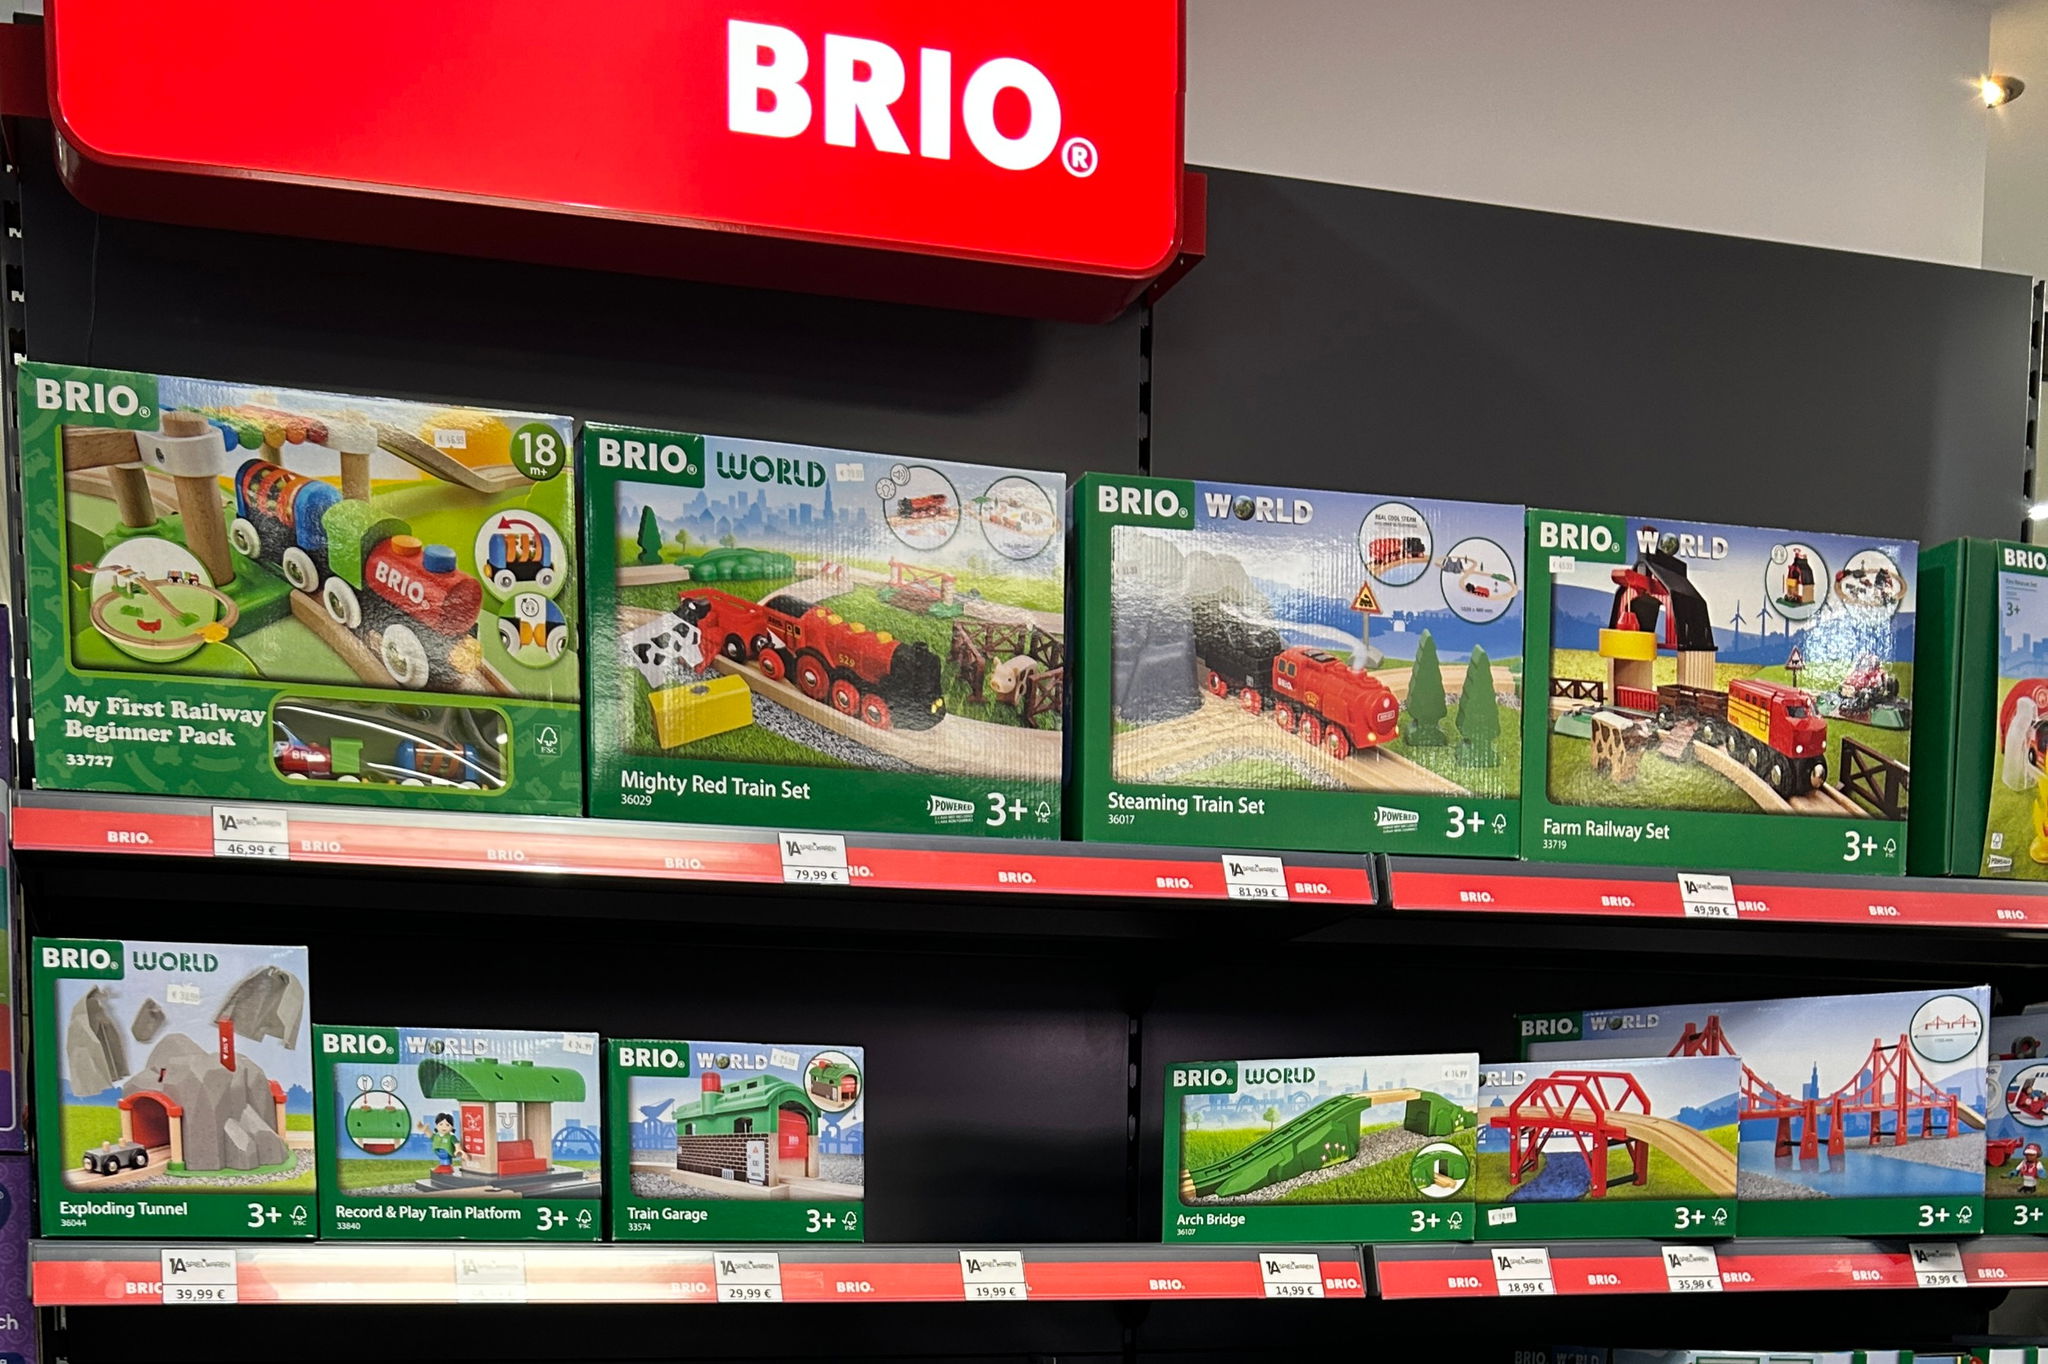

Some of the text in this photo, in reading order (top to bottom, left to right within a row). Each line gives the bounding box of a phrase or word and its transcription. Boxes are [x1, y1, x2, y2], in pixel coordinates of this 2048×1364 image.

[518, 432, 557, 466] 18
[716, 451, 826, 487] WORLD
[1204, 492, 1314, 524] WORLD
[1636, 530, 1729, 559] WORLD
[2006, 601, 2021, 617] 3+
[64, 695, 266, 727] My First Railway
[65, 719, 236, 746] Beginner Pack
[66, 754, 113, 768] 33727
[621, 770, 810, 800] Mighty Red Train Set
[621, 794, 652, 806] 36029
[935, 800, 972, 811] POWERED
[1108, 791, 1265, 815] Steaming Train Set
[986, 792, 1028, 826] 3+
[1382, 810, 1417, 821] POWERED
[1108, 814, 1134, 824] 36017
[1446, 805, 1485, 838] 3+
[1543, 818, 1670, 842] Farm Railway Set
[228, 843, 277, 856] 46,99 €
[1543, 840, 1567, 850] 33719
[1843, 830, 1877, 861] 3+
[795, 869, 838, 881] 79,99 €
[1239, 887, 1278, 899] 81,99 €
[1694, 905, 1729, 916] 49,99 €
[133, 951, 218, 972] WORLD
[1590, 1014, 1659, 1031] WORLD
[407, 1036, 488, 1056] WORLD
[696, 1052, 768, 1070] WORLD
[1245, 1066, 1315, 1084] WORLD
[60, 1202, 188, 1218] Exploding Tunnel
[248, 1203, 282, 1228] 3+
[336, 1205, 521, 1221] Record & Play Train Platform
[627, 1207, 708, 1223] Train Garage
[1675, 1207, 1705, 1228] 3+
[1918, 1205, 1950, 1227] 3+
[2013, 1205, 2043, 1225] 3+
[60, 1219, 87, 1227] 36044
[337, 1222, 360, 1230] 33840
[537, 1207, 568, 1231] 3+
[628, 1223, 651, 1231] 33574
[806, 1209, 836, 1232] 3+
[1177, 1213, 1245, 1227] Arch Bridge
[1410, 1210, 1440, 1232] 3+
[1177, 1228, 1196, 1236] 36107
[1508, 1282, 1544, 1293] 18,99 €
[1707, 1280, 1713, 1289] €
[1926, 1275, 1959, 1285] 29,99 €
[176, 1289, 225, 1302] 39,99 €
[730, 1288, 771, 1299] 29,99 €
[976, 1287, 1016, 1298] 19,99 €
[1276, 1286, 1314, 1297] 14,99 €
